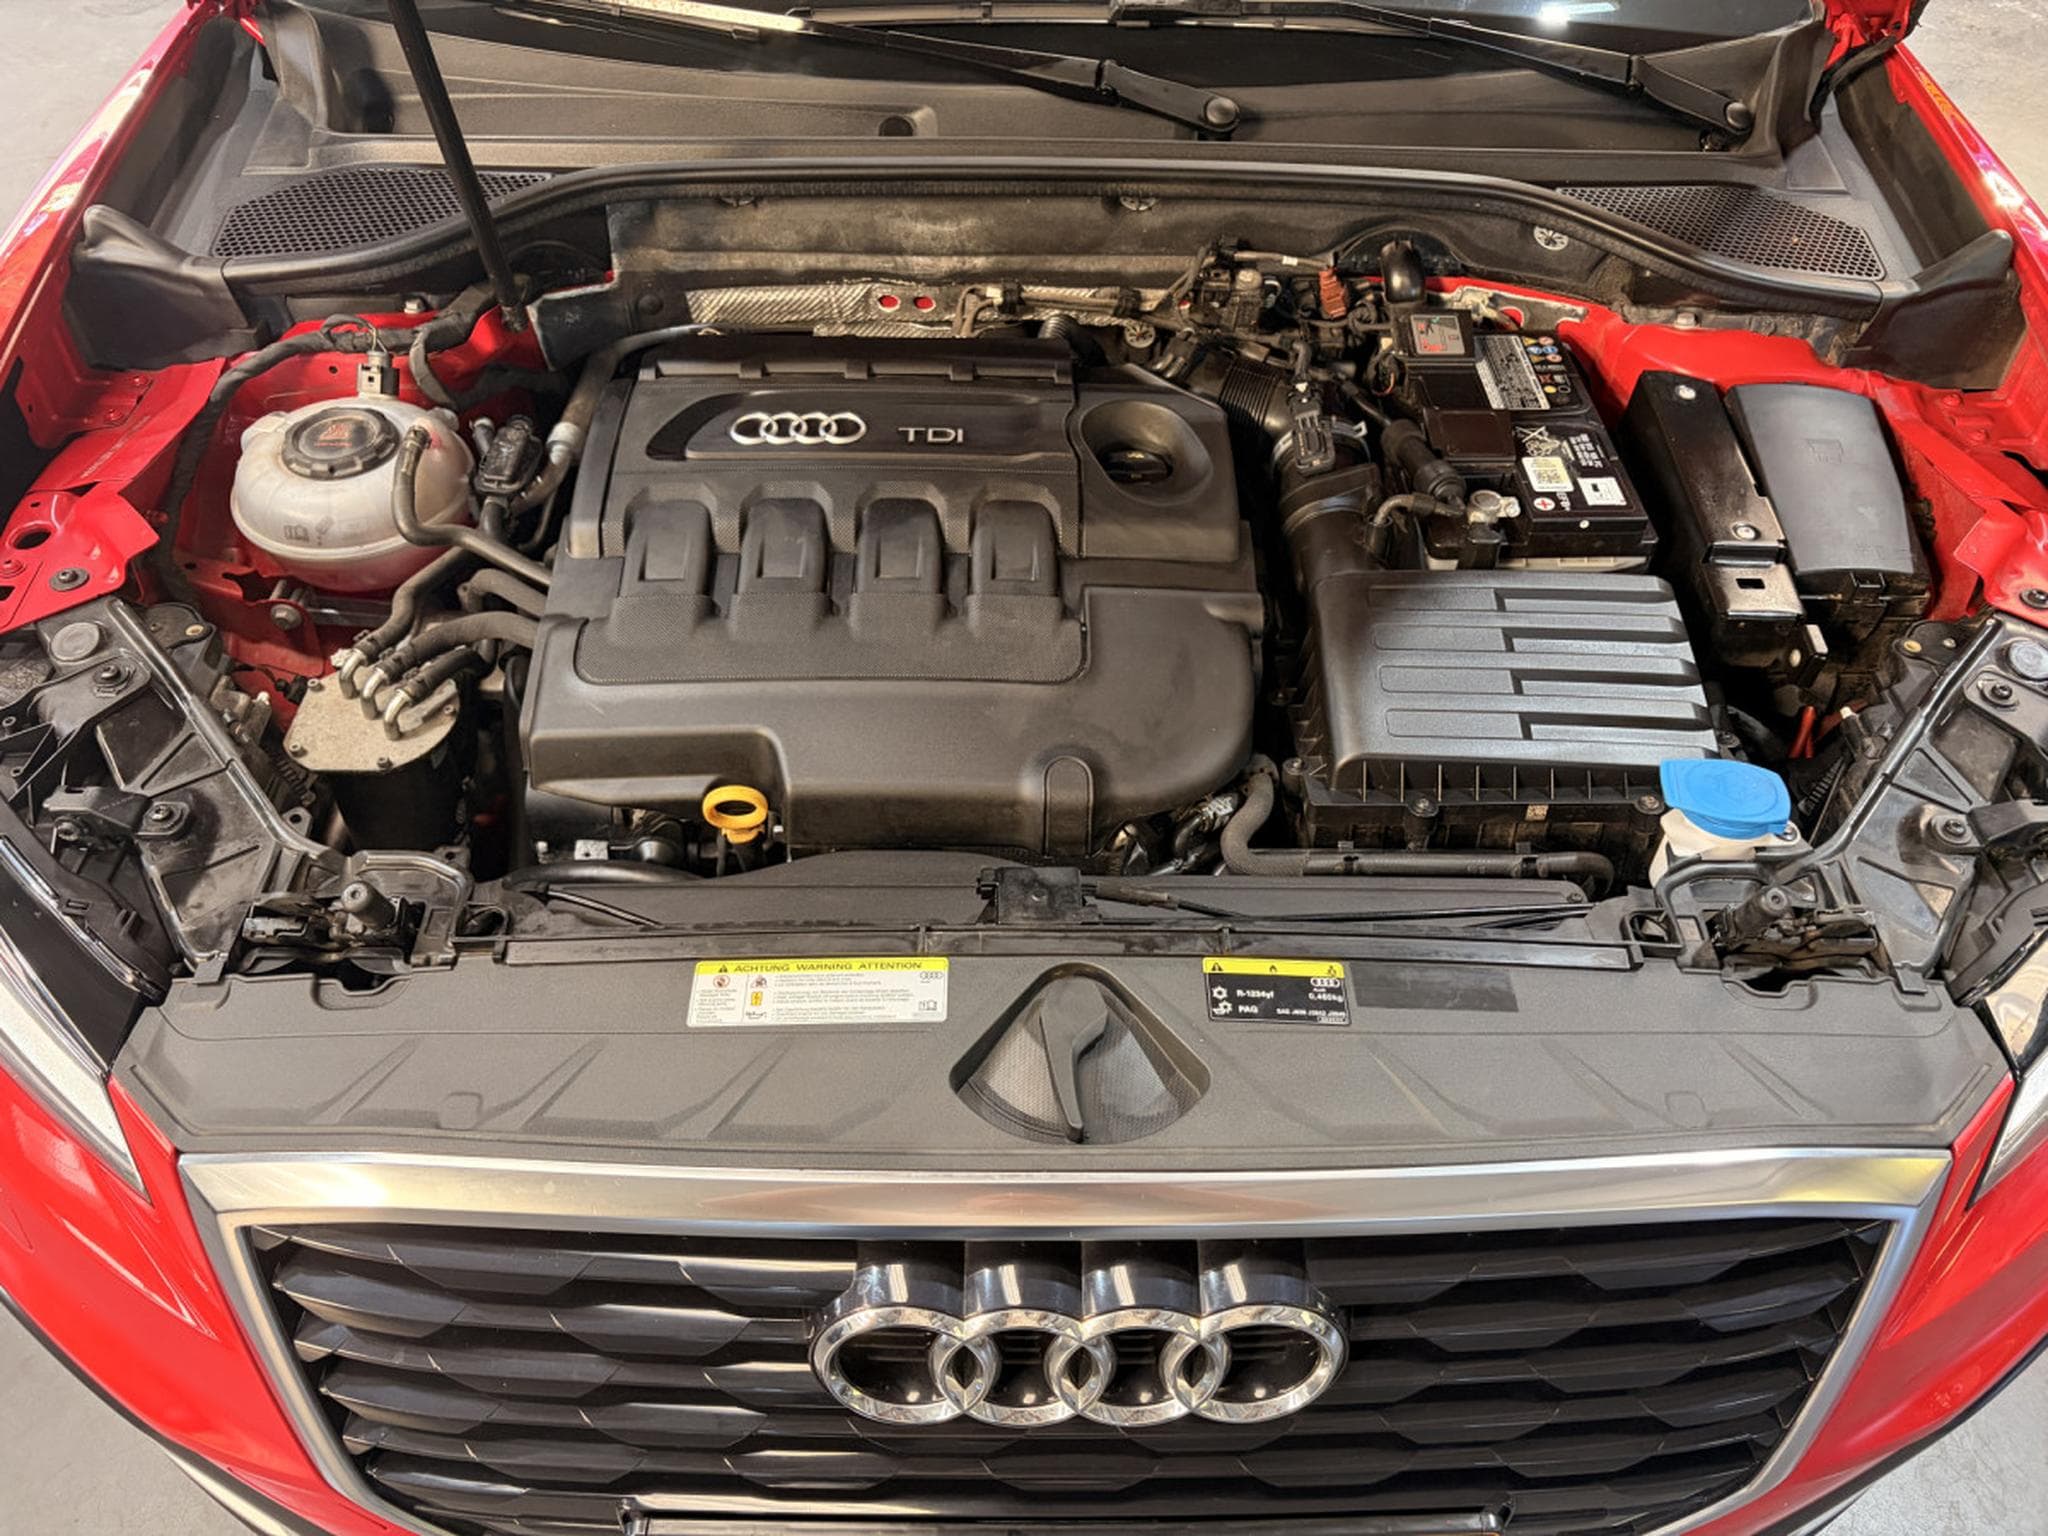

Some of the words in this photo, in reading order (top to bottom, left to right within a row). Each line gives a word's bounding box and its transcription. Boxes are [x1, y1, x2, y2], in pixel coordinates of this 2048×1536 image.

[898, 427, 964, 443] TDI
[734, 963, 790, 972] ACHTUNG
[1238, 1004, 1258, 1014] PAG
